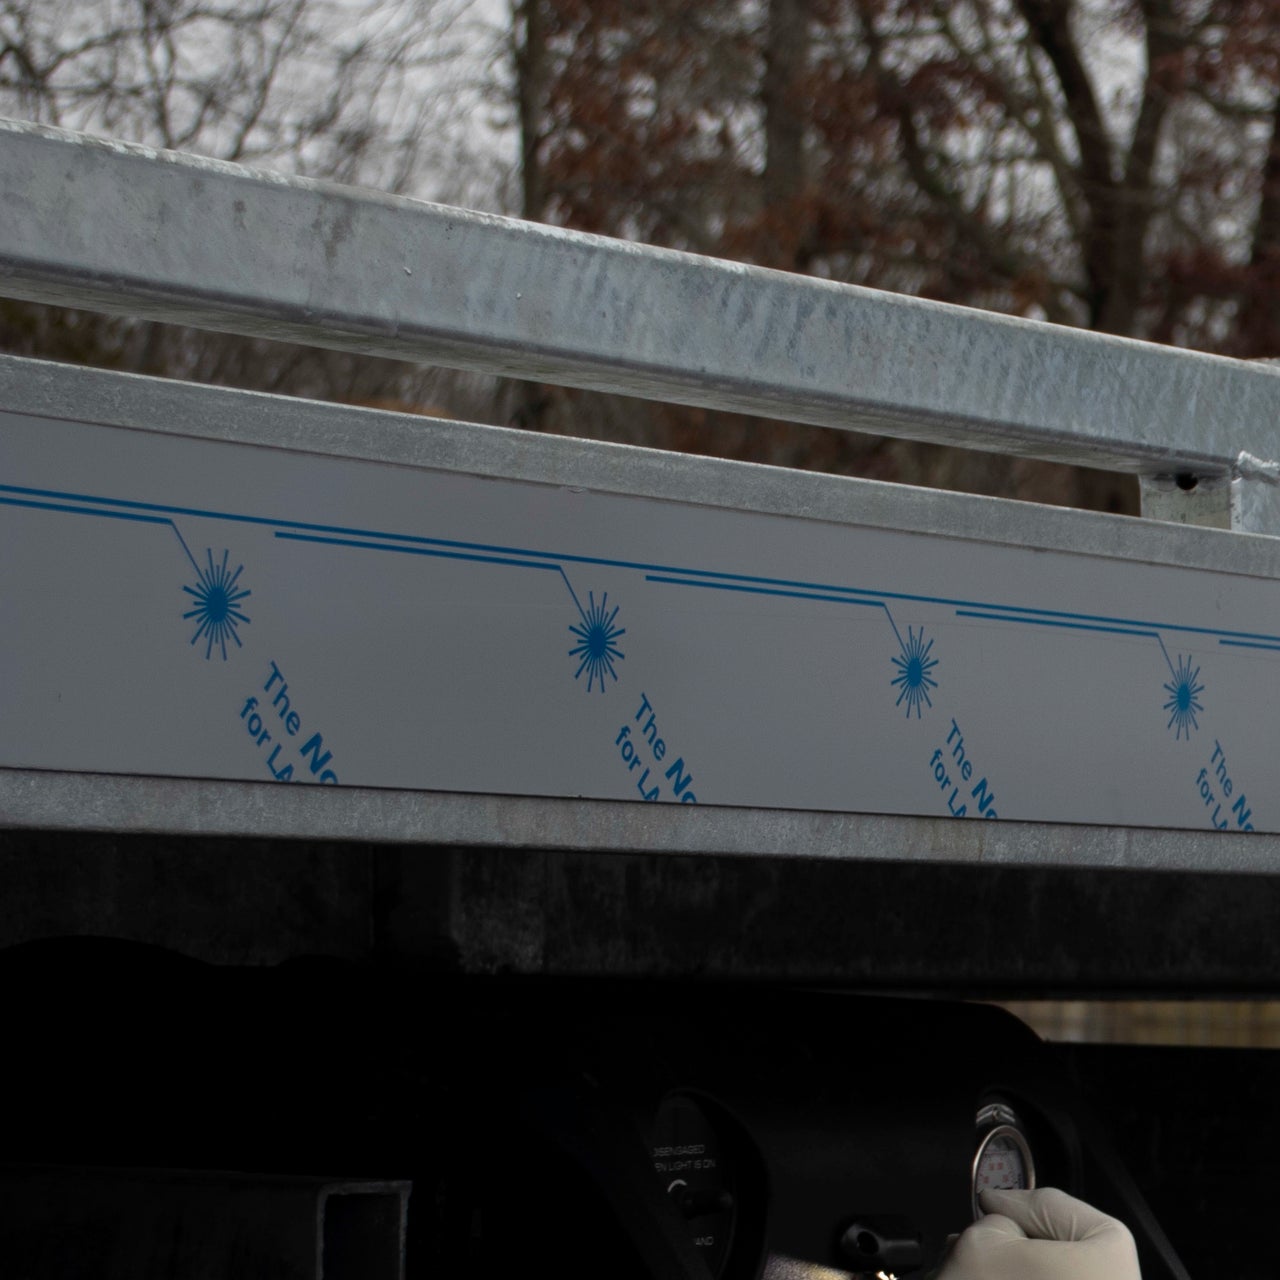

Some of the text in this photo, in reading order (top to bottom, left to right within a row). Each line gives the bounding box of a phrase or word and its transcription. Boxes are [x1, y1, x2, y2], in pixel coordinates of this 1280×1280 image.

[240, 697, 272, 747] for
[263, 660, 301, 737] The
[615, 725, 641, 771] for
[635, 692, 666, 761] The
[947, 718, 972, 781] The
[930, 748, 951, 791] for
[1196, 768, 1215, 806] for
[1211, 739, 1232, 798] The
